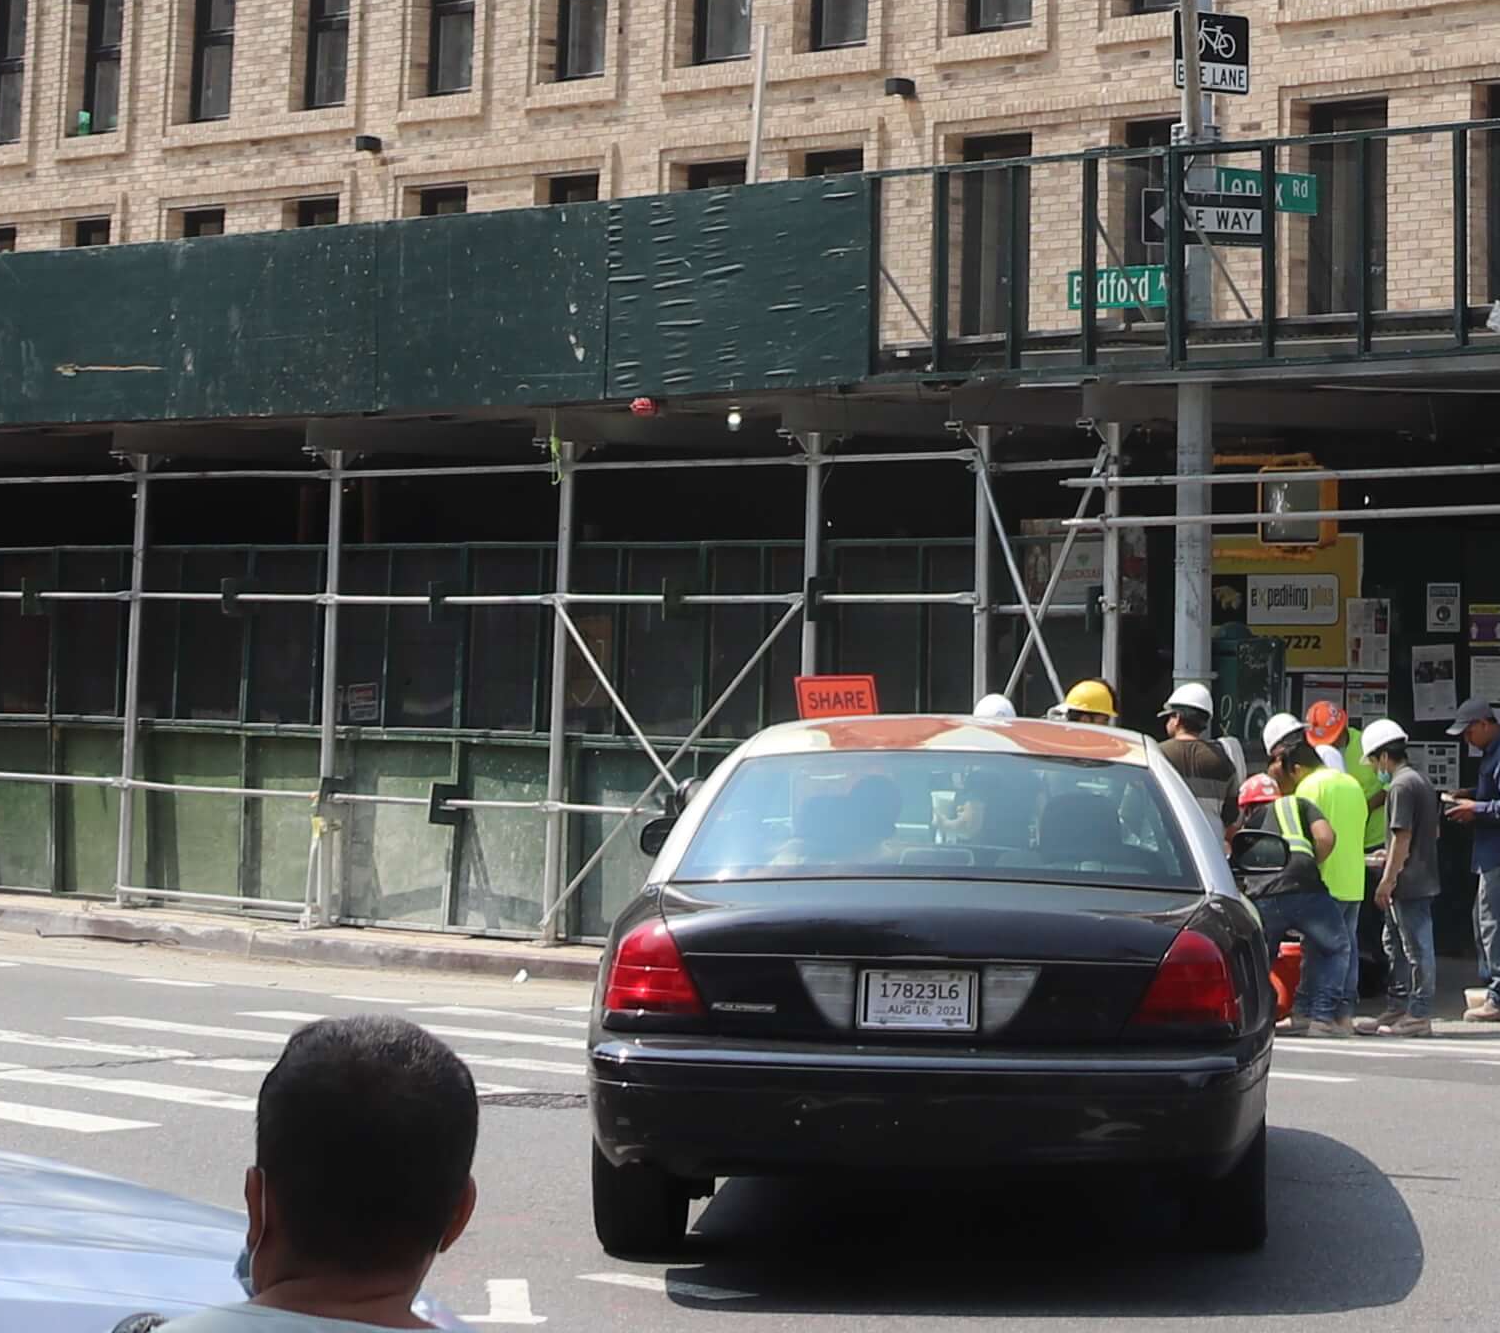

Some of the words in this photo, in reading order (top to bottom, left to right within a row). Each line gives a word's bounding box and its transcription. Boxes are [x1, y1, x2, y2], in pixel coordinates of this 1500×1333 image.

[1177, 63, 1207, 84] BE
[1211, 66, 1246, 89] LANE
[1292, 179, 1309, 199] Rd
[1216, 210, 1255, 231] WAY
[808, 690, 869, 710] SHARE
[880, 982, 960, 1001] 17823L6
[887, 1005, 913, 1015] AUG
[915, 1006, 932, 1017] 16,
[937, 1005, 963, 1016] 2021
